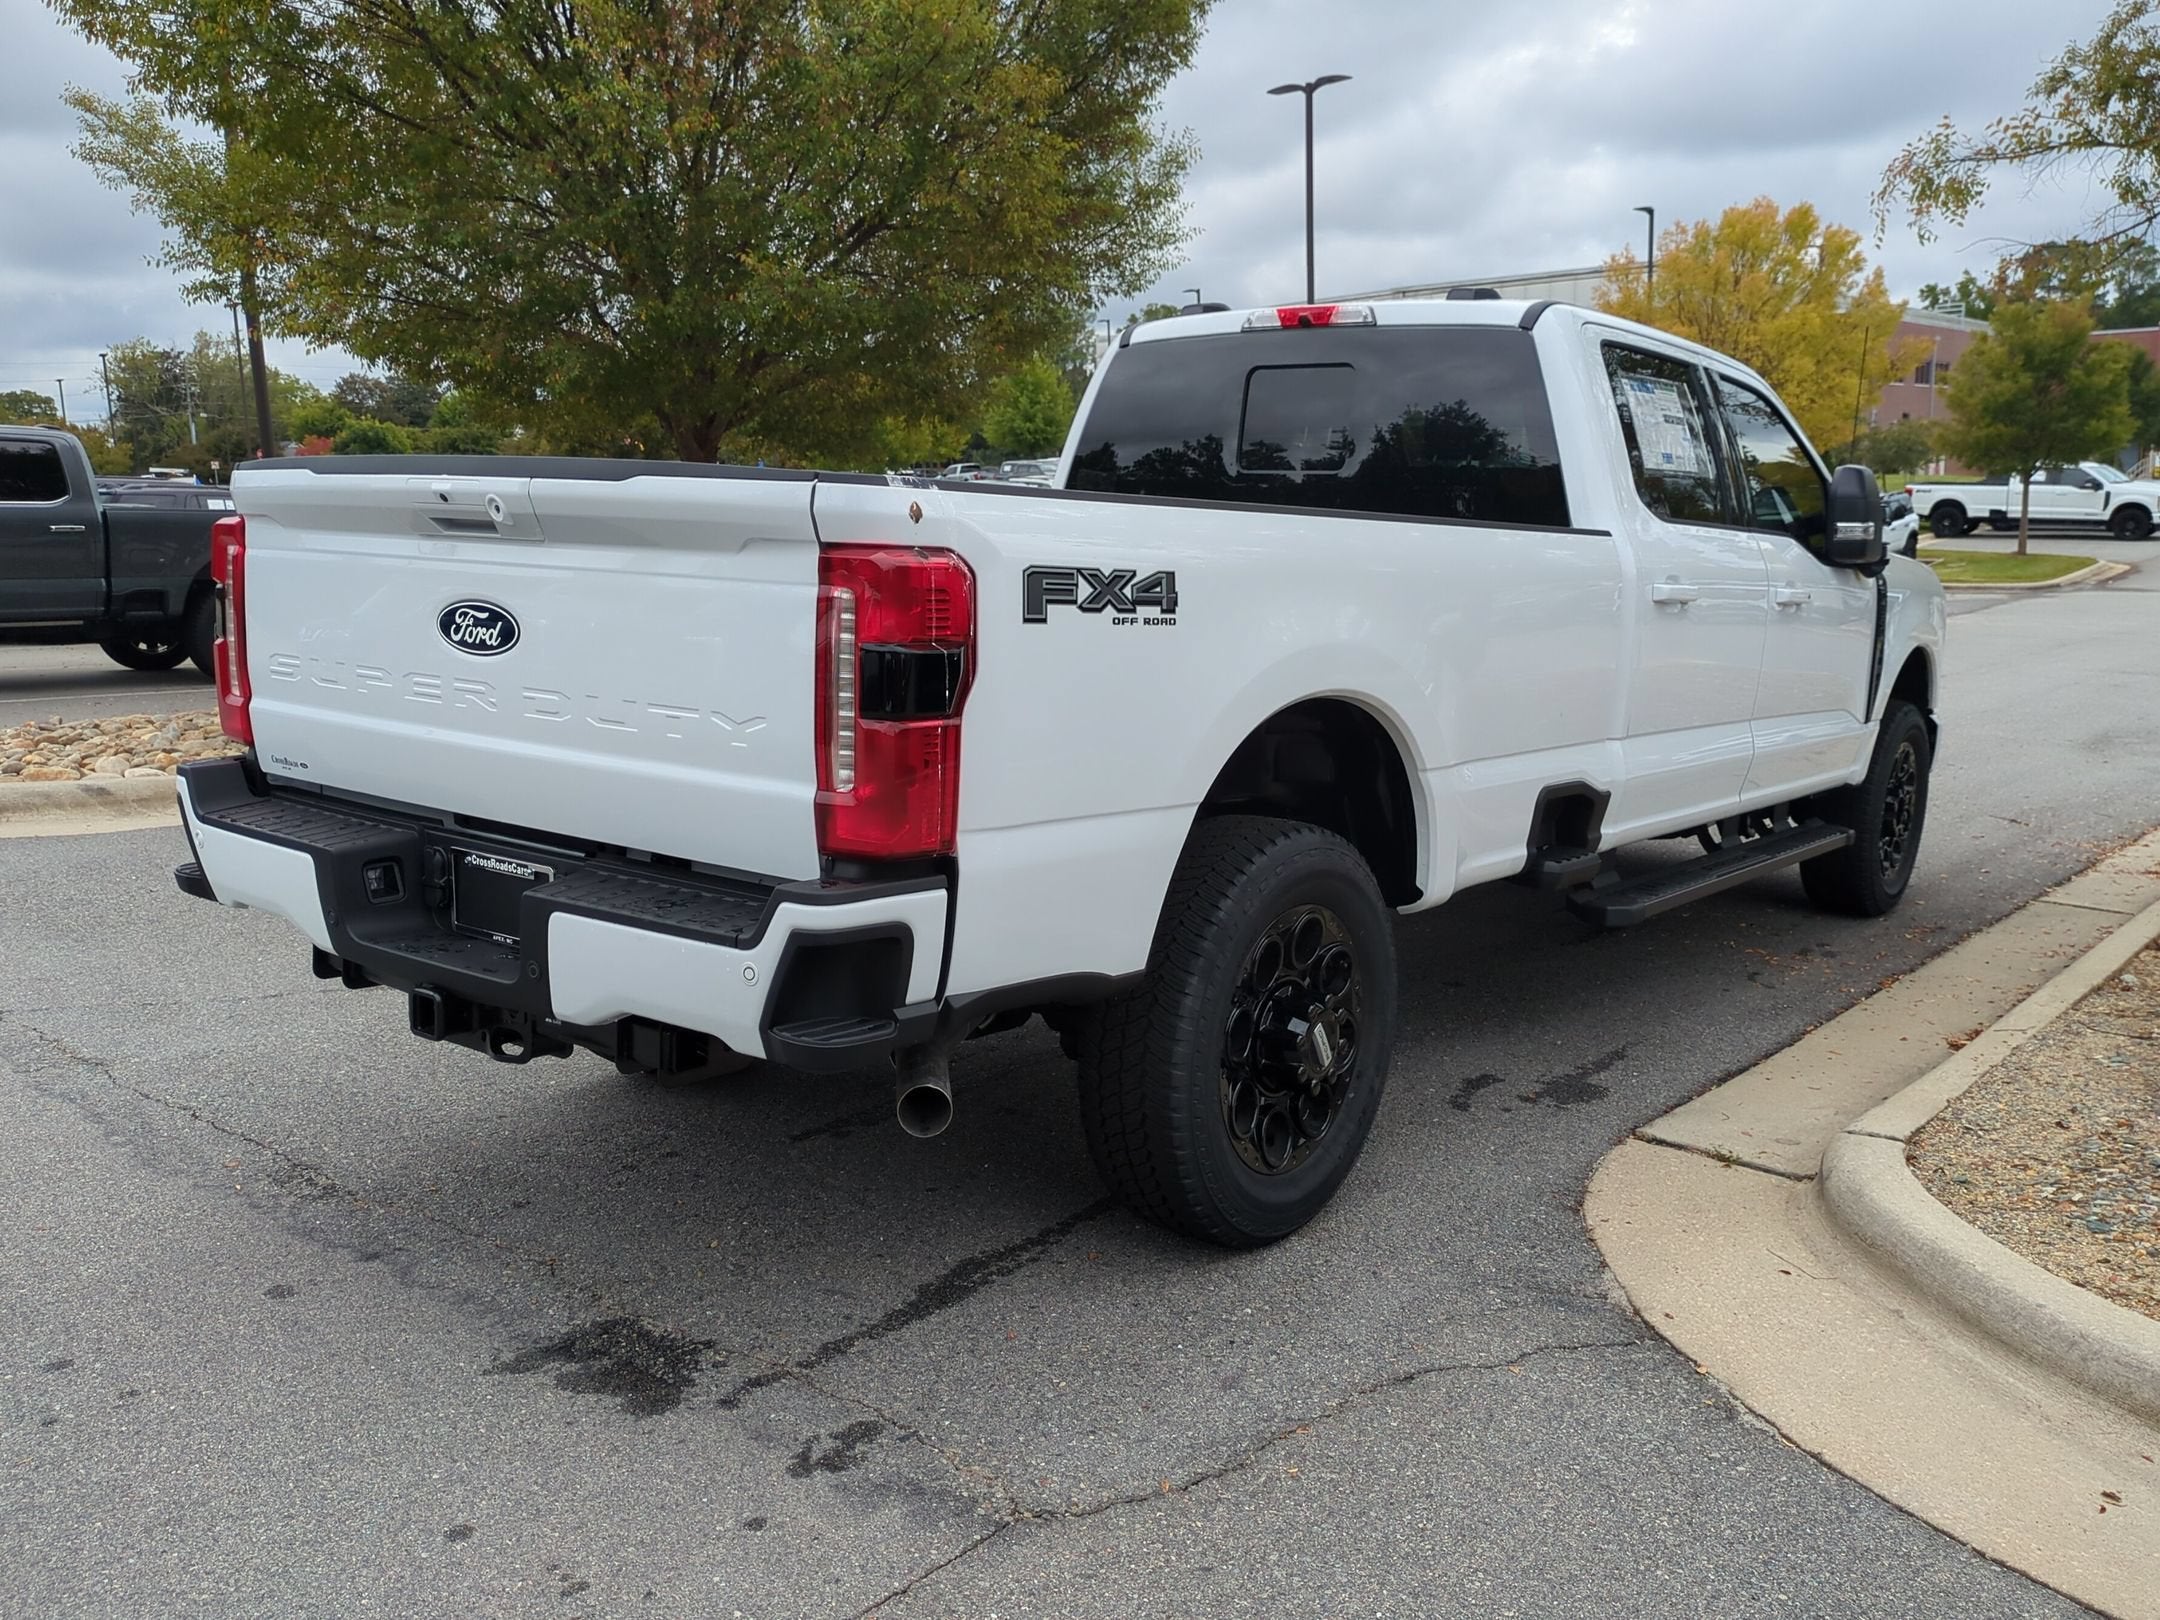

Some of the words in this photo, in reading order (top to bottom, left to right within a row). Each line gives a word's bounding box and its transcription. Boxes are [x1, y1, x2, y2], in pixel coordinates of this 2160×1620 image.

[1022, 564, 1178, 624] FX4
[451, 607, 502, 646] Ford
[1112, 617, 1139, 626] OFF
[1143, 617, 1177, 626] ROAD
[269, 652, 498, 712] SUPER
[522, 686, 767, 747] DUTY
